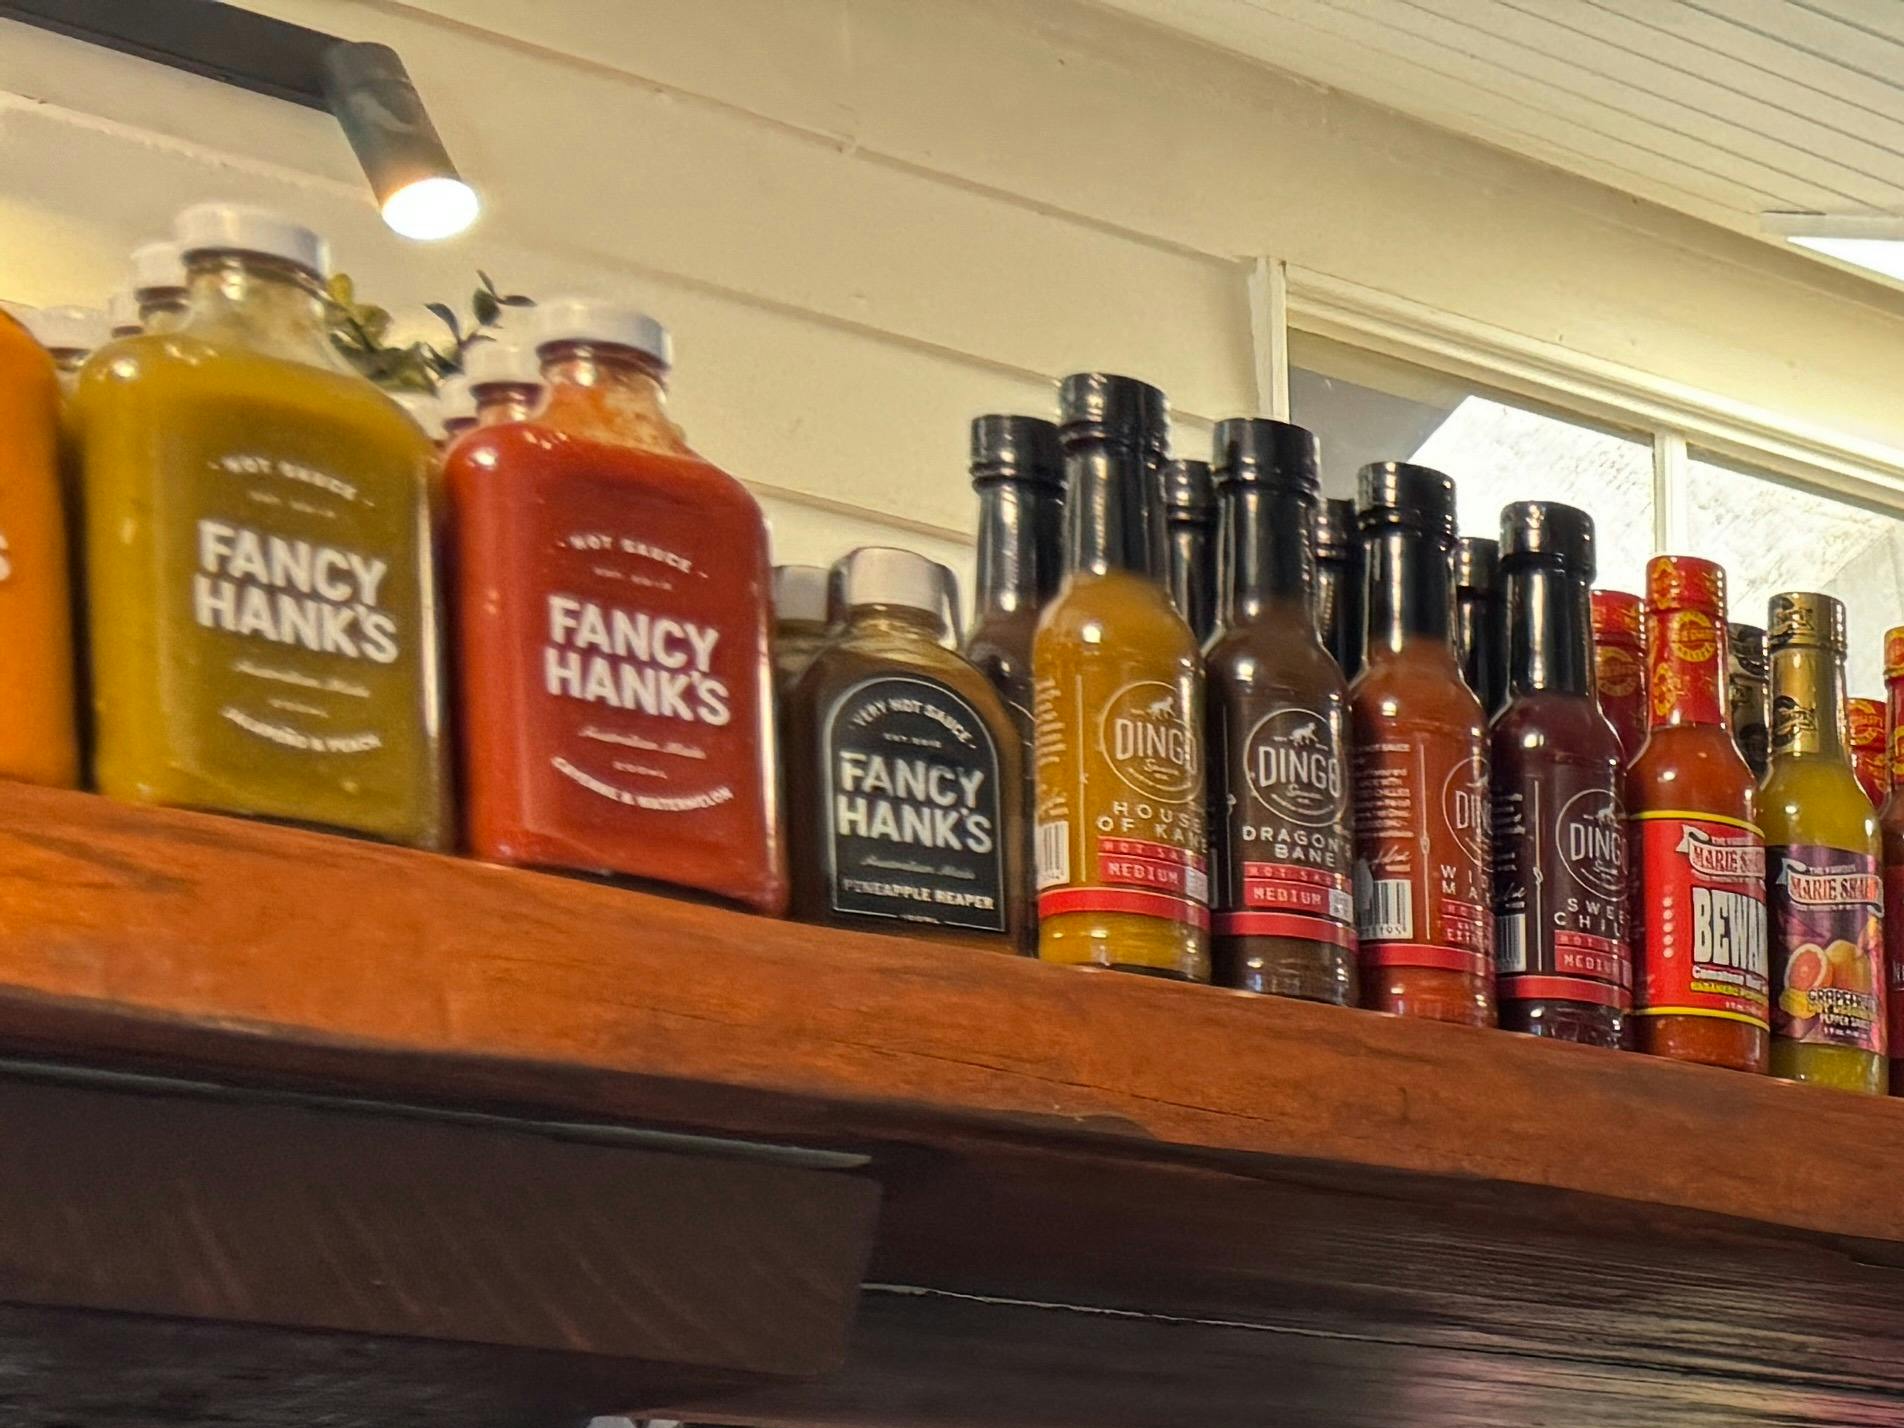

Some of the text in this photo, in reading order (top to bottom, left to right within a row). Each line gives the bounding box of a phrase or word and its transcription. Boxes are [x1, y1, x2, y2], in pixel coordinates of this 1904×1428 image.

[198, 519, 387, 606] FANCY
[195, 573, 398, 664] HANK'S
[547, 594, 719, 673] FANCY
[544, 647, 731, 726] HANK'S
[889, 698, 920, 713] HOT
[839, 750, 984, 809] FANCY
[837, 795, 992, 854] HANK'S
[1096, 816, 1136, 832] OF
[1274, 844, 1337, 867] BANE
[935, 886, 995, 910] REAPER
